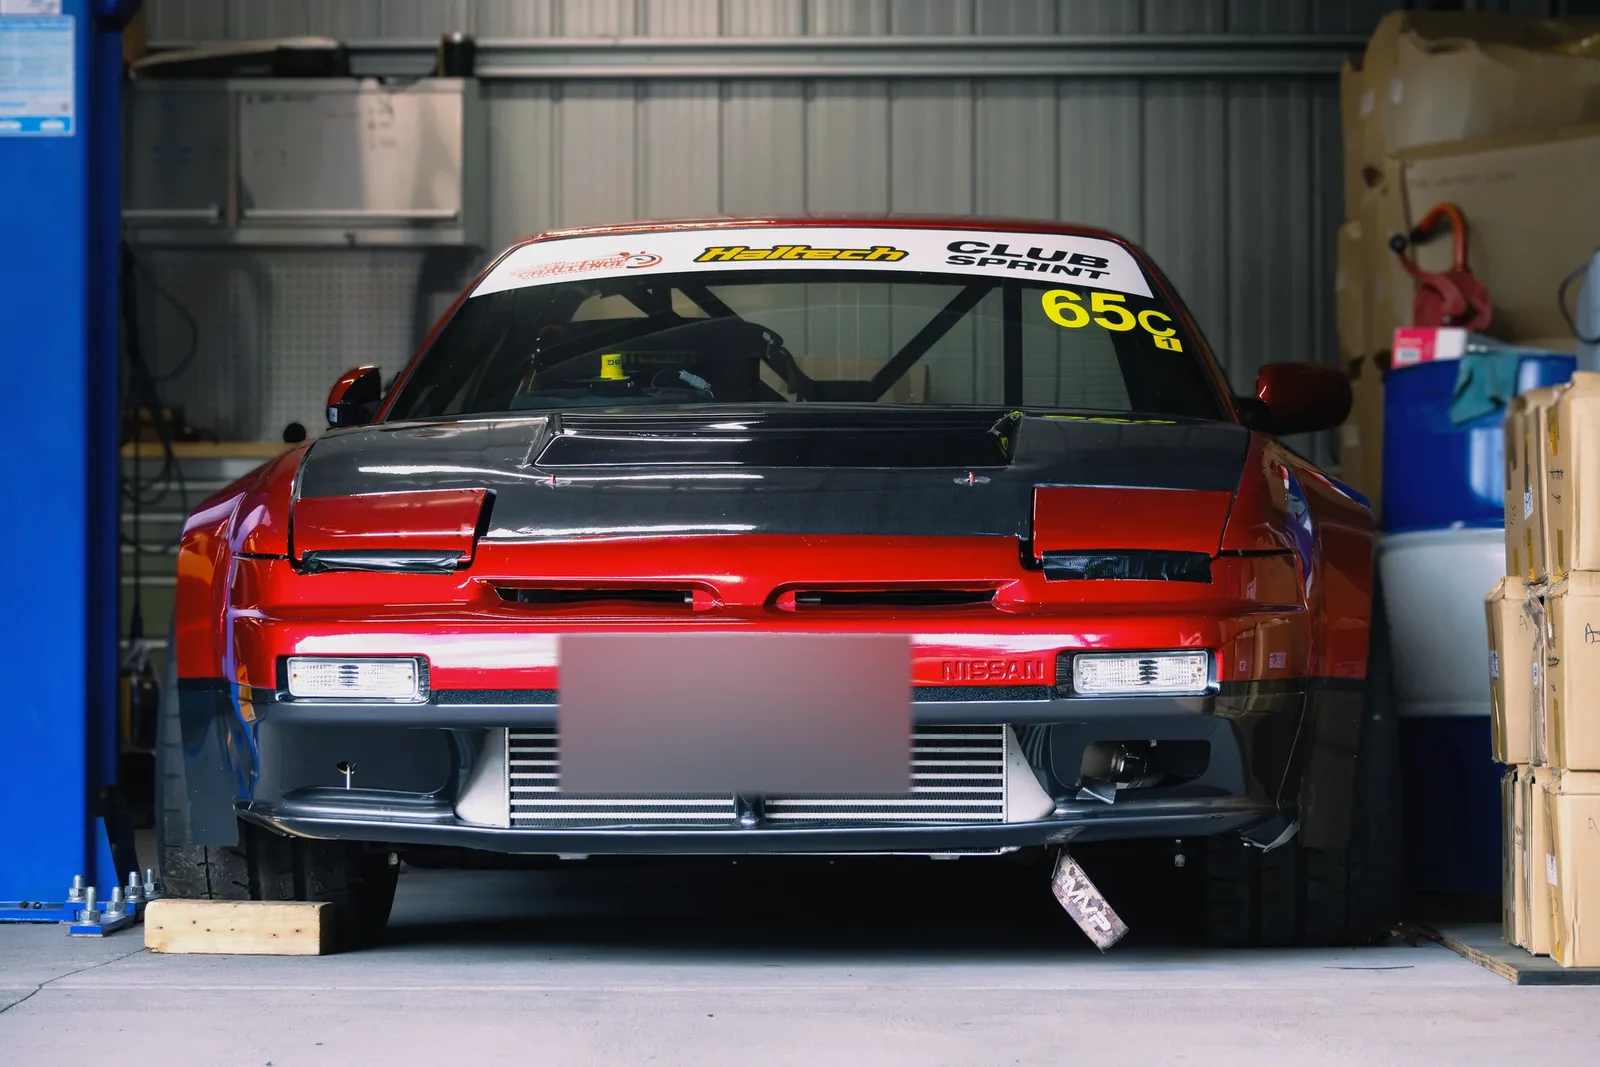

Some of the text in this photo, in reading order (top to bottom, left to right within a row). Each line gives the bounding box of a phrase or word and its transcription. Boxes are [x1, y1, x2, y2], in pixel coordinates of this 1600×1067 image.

[694, 245, 909, 262] Haltech
[946, 241, 1110, 269] CLUB
[945, 255, 1111, 280] SPRINT
[942, 660, 1045, 681] NISSAN
[1061, 876, 1112, 932] MVP
